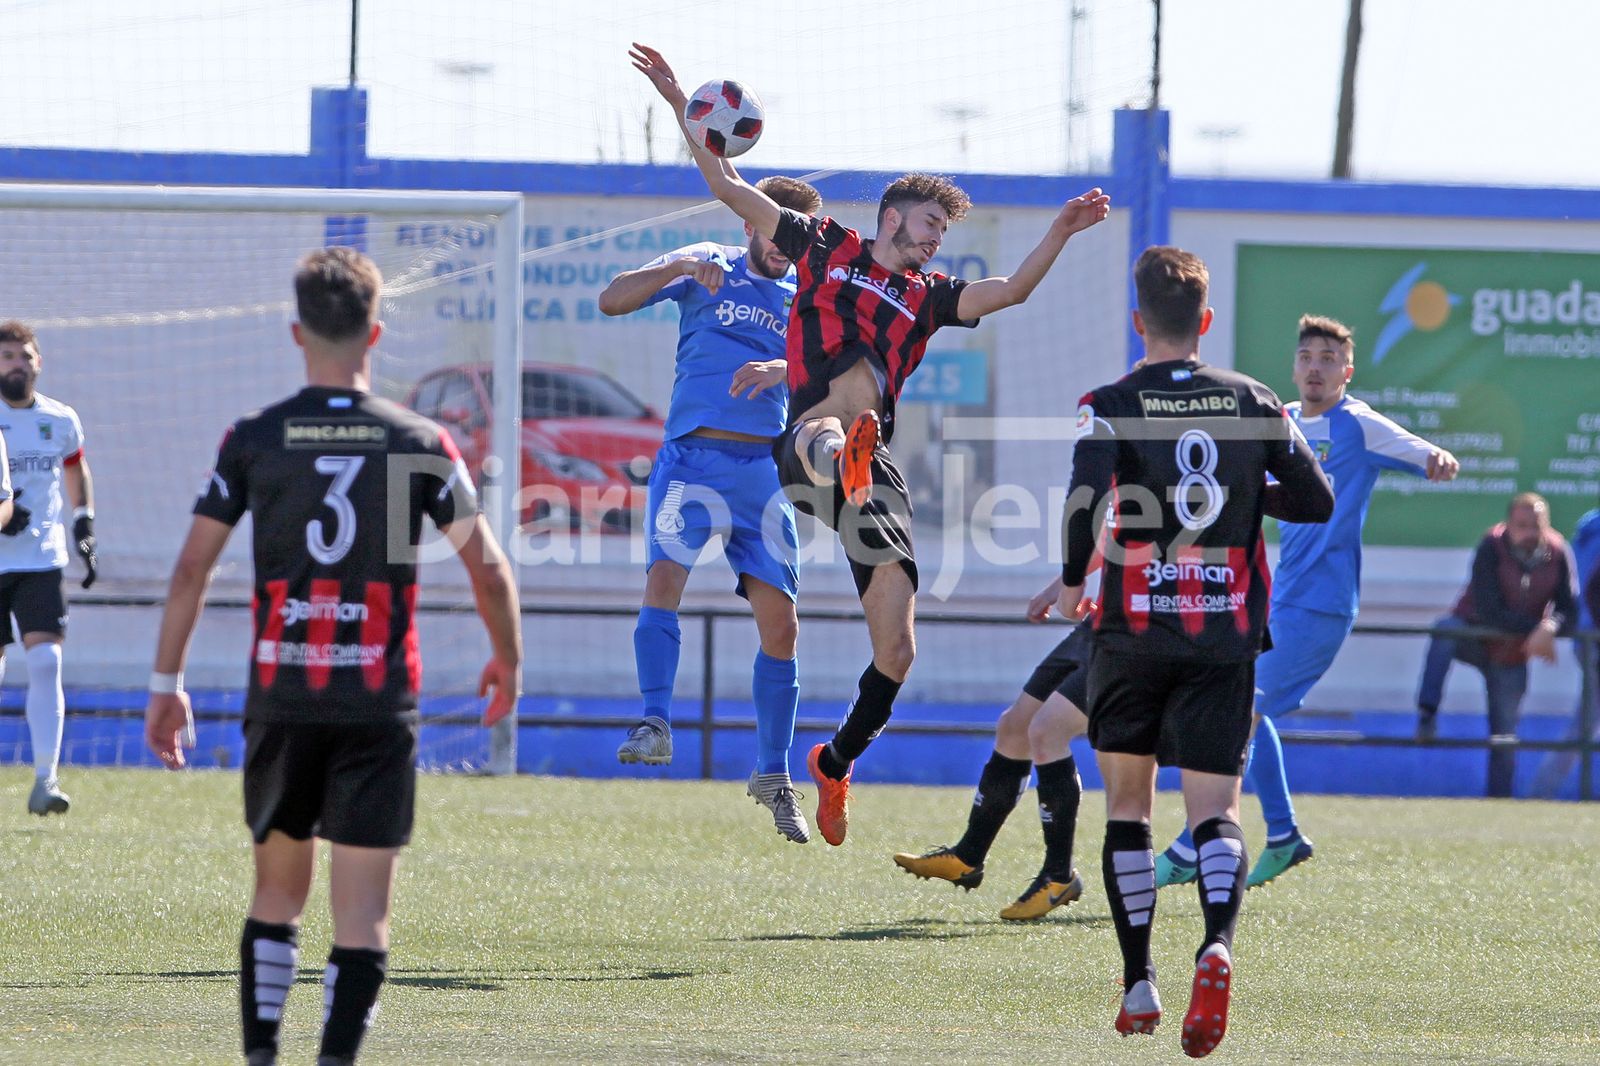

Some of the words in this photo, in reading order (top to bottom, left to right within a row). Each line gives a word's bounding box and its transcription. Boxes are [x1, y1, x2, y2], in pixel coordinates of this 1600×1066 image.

[715, 299, 787, 339] Beima
[1174, 429, 1224, 531] 8
[306, 455, 366, 564] 3
[1142, 559, 1235, 587] Beiman
[1152, 594, 1193, 607] DENTAL
[1195, 591, 1246, 608] COMPANY
